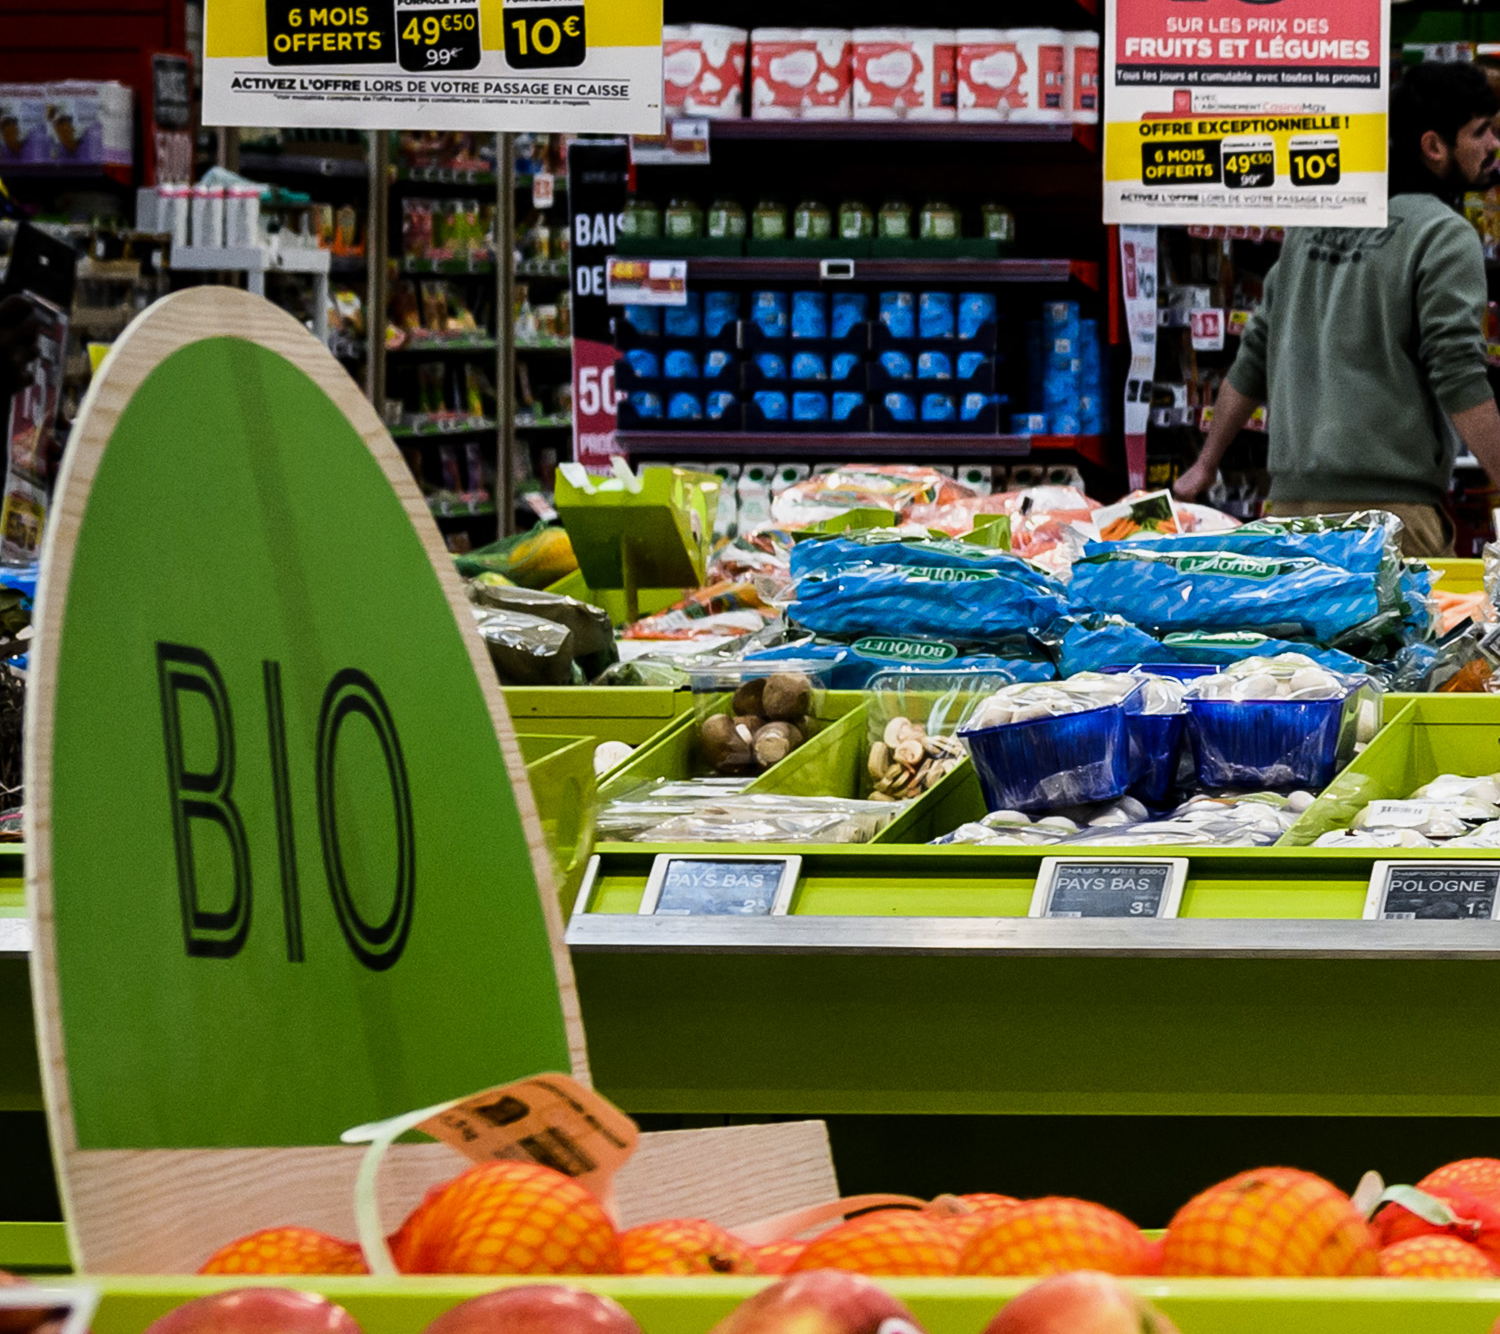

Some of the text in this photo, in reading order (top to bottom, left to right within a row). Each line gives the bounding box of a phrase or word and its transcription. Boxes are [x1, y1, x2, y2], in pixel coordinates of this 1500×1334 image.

[289, 7, 368, 27] 6 MOIS
[274, 31, 381, 52] OFFERTS
[512, 16, 580, 54] 10€
[231, 79, 628, 97] ACTIVEZ L'OFFRE LORS DE VOTRE PASSAGE EN CAISSE
[156, 641, 417, 972] BIO
[667, 874, 763, 887] PAYS BAS
[1057, 878, 1150, 890] PAYS BAS
[1390, 880, 1486, 892] POLOGNE
